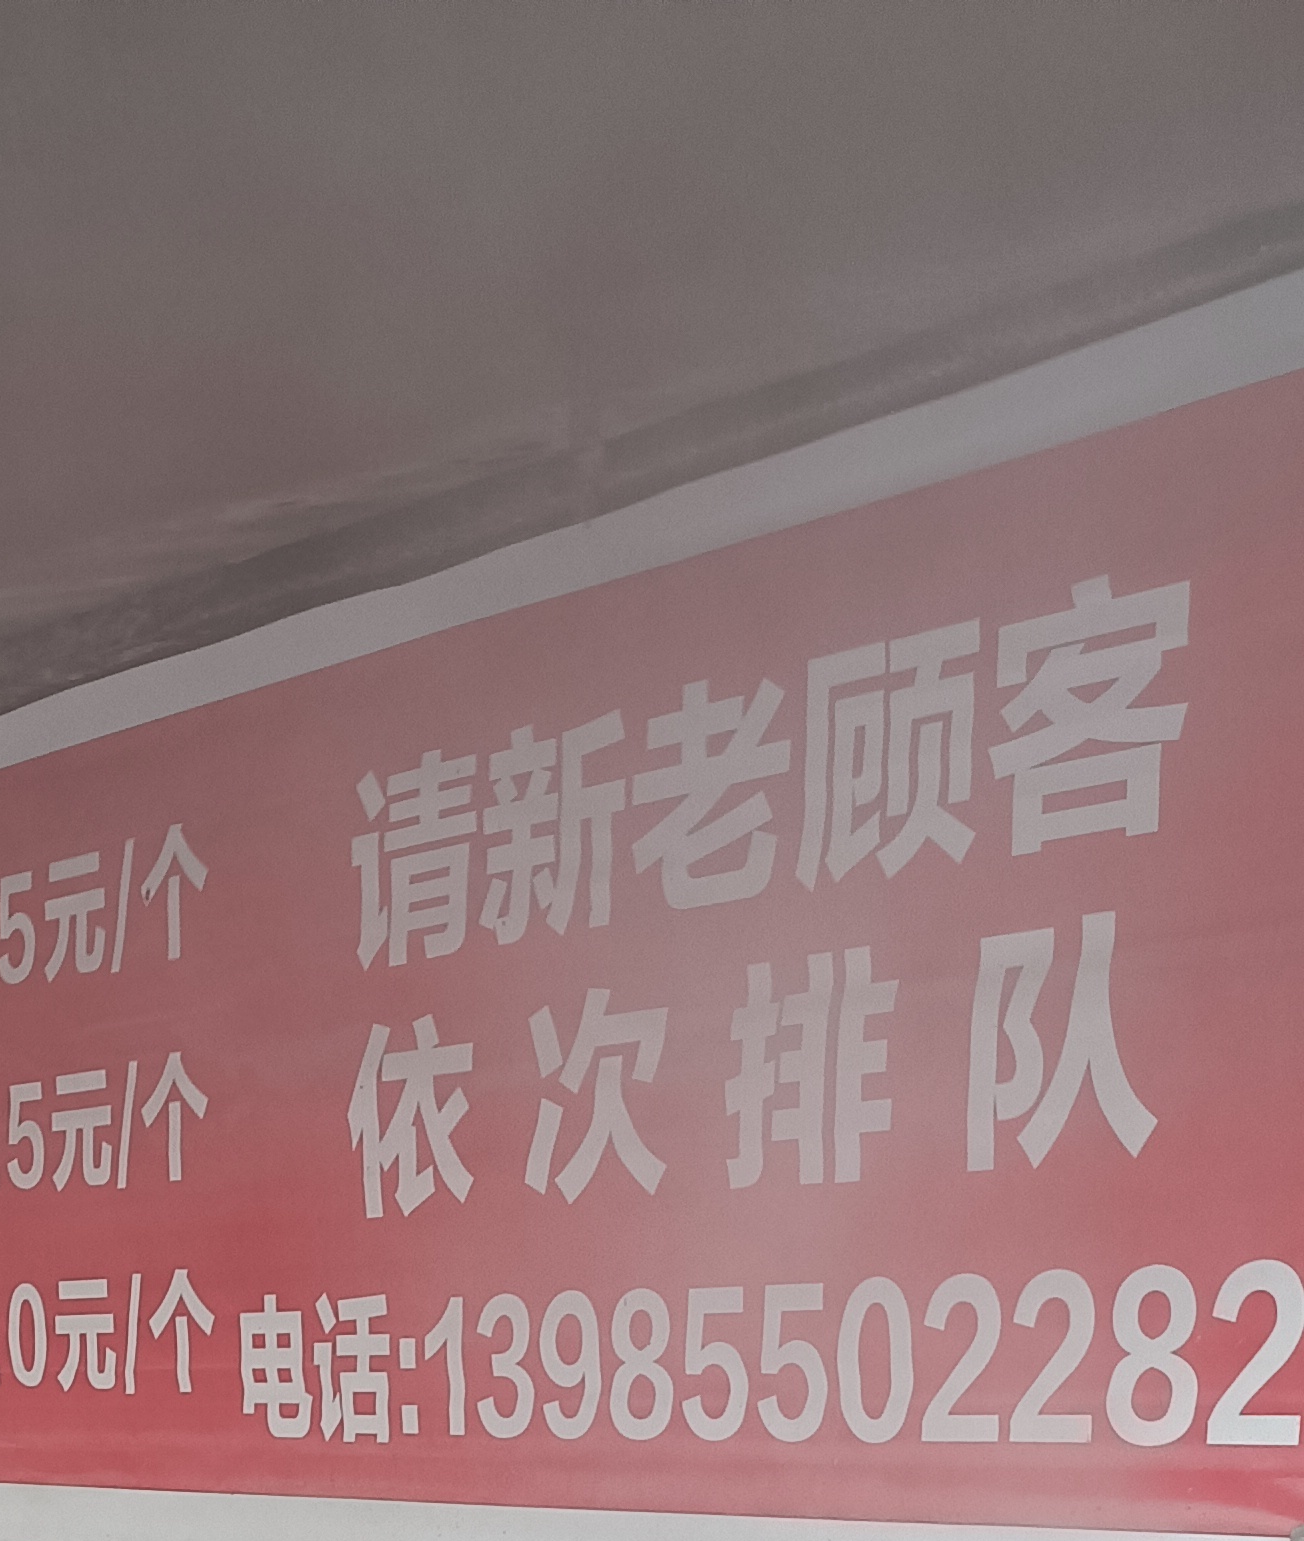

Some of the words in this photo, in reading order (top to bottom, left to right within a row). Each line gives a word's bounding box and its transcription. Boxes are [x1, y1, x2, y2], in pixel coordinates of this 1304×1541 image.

[351, 573, 1191, 971] 请新老顾客
[347, 910, 1159, 1219] 依次排队
[239, 1258, 1304, 1448] 电话:13985502282
